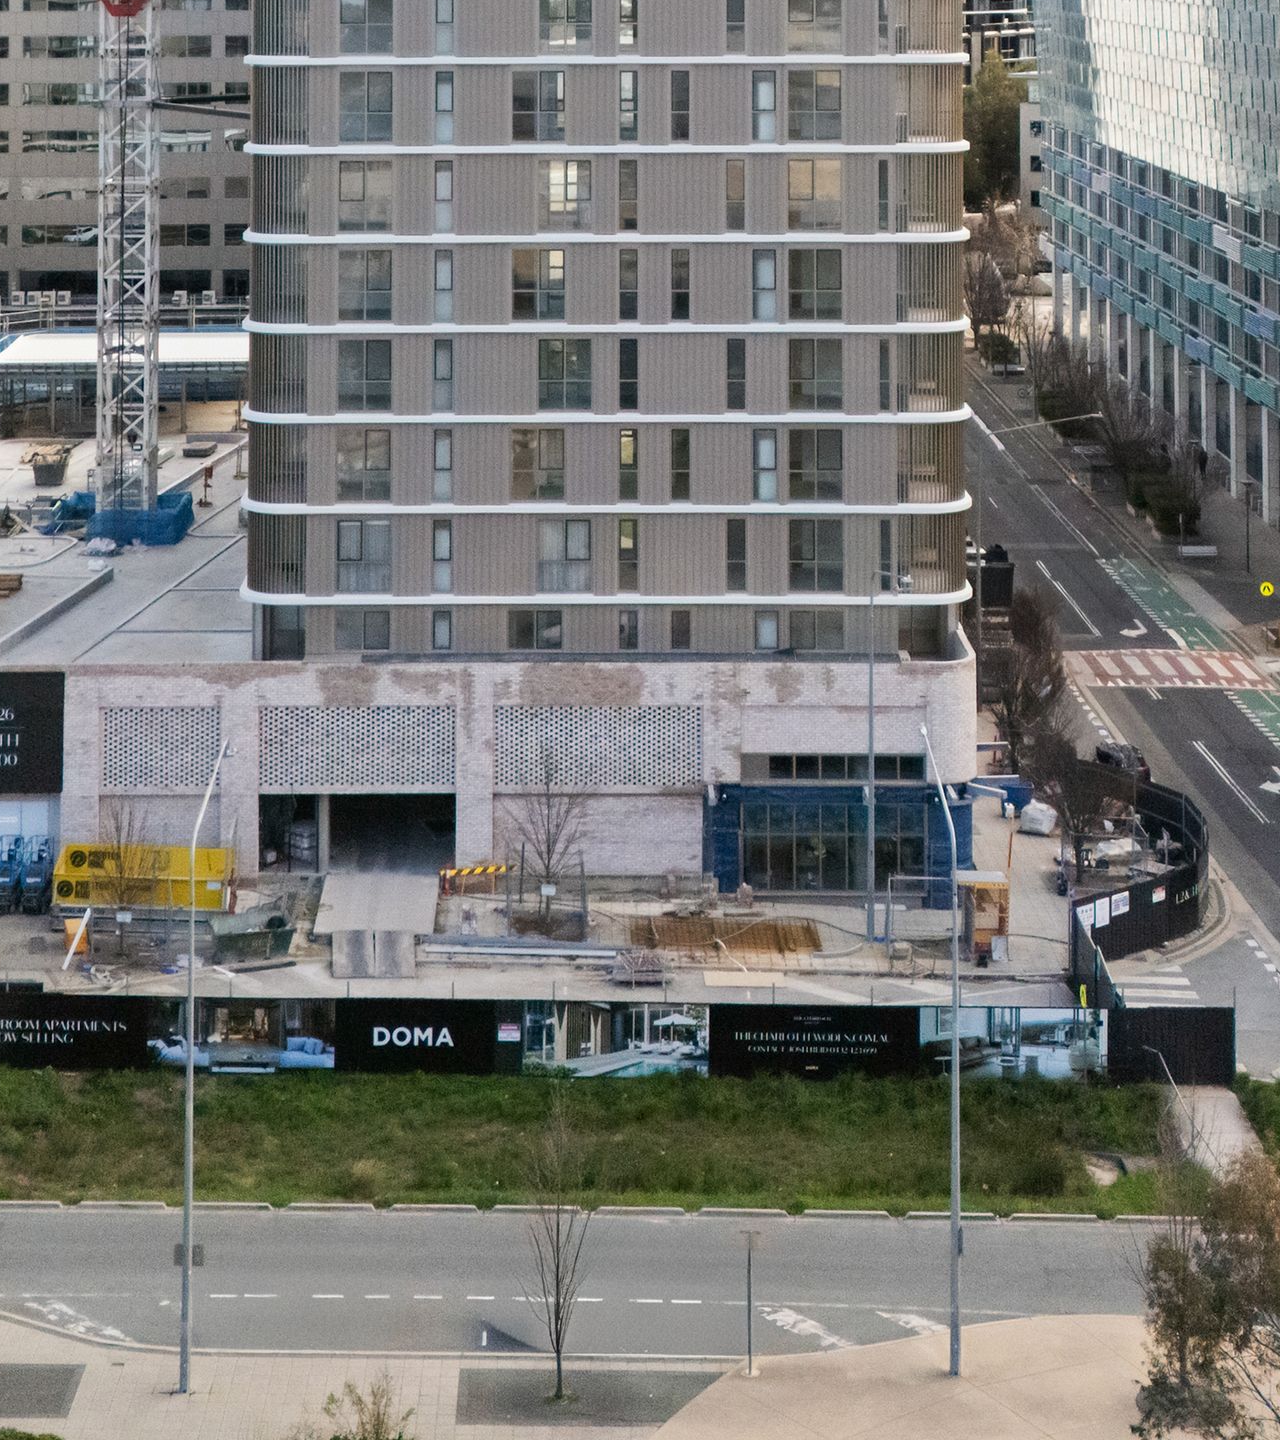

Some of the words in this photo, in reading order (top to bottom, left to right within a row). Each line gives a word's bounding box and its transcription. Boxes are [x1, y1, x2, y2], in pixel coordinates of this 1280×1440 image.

[43, 1018, 127, 1032] APARTMENTS
[21, 1032, 74, 1044] SELLING
[373, 1026, 455, 1047] DOMA
